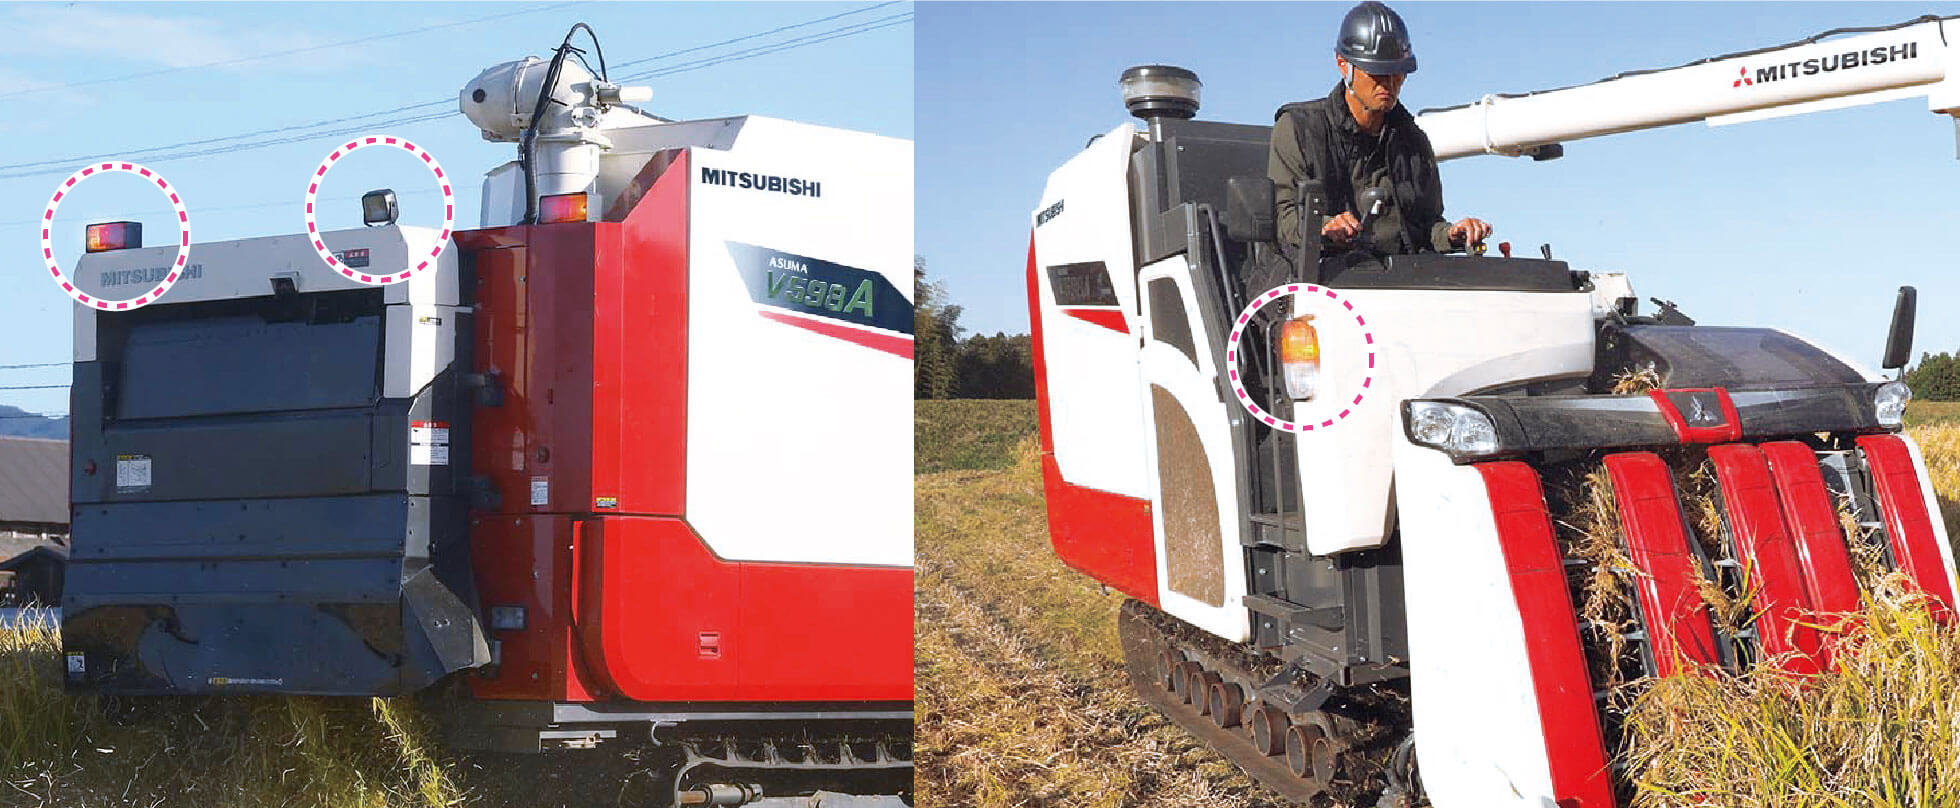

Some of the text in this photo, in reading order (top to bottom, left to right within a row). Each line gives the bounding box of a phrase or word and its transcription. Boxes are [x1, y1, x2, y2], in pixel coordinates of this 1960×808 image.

[1756, 42, 1918, 83] MITSUBISHI
[701, 166, 821, 198] MITSUBISHI
[768, 257, 808, 274] ASUMA
[766, 270, 874, 317] V598A
